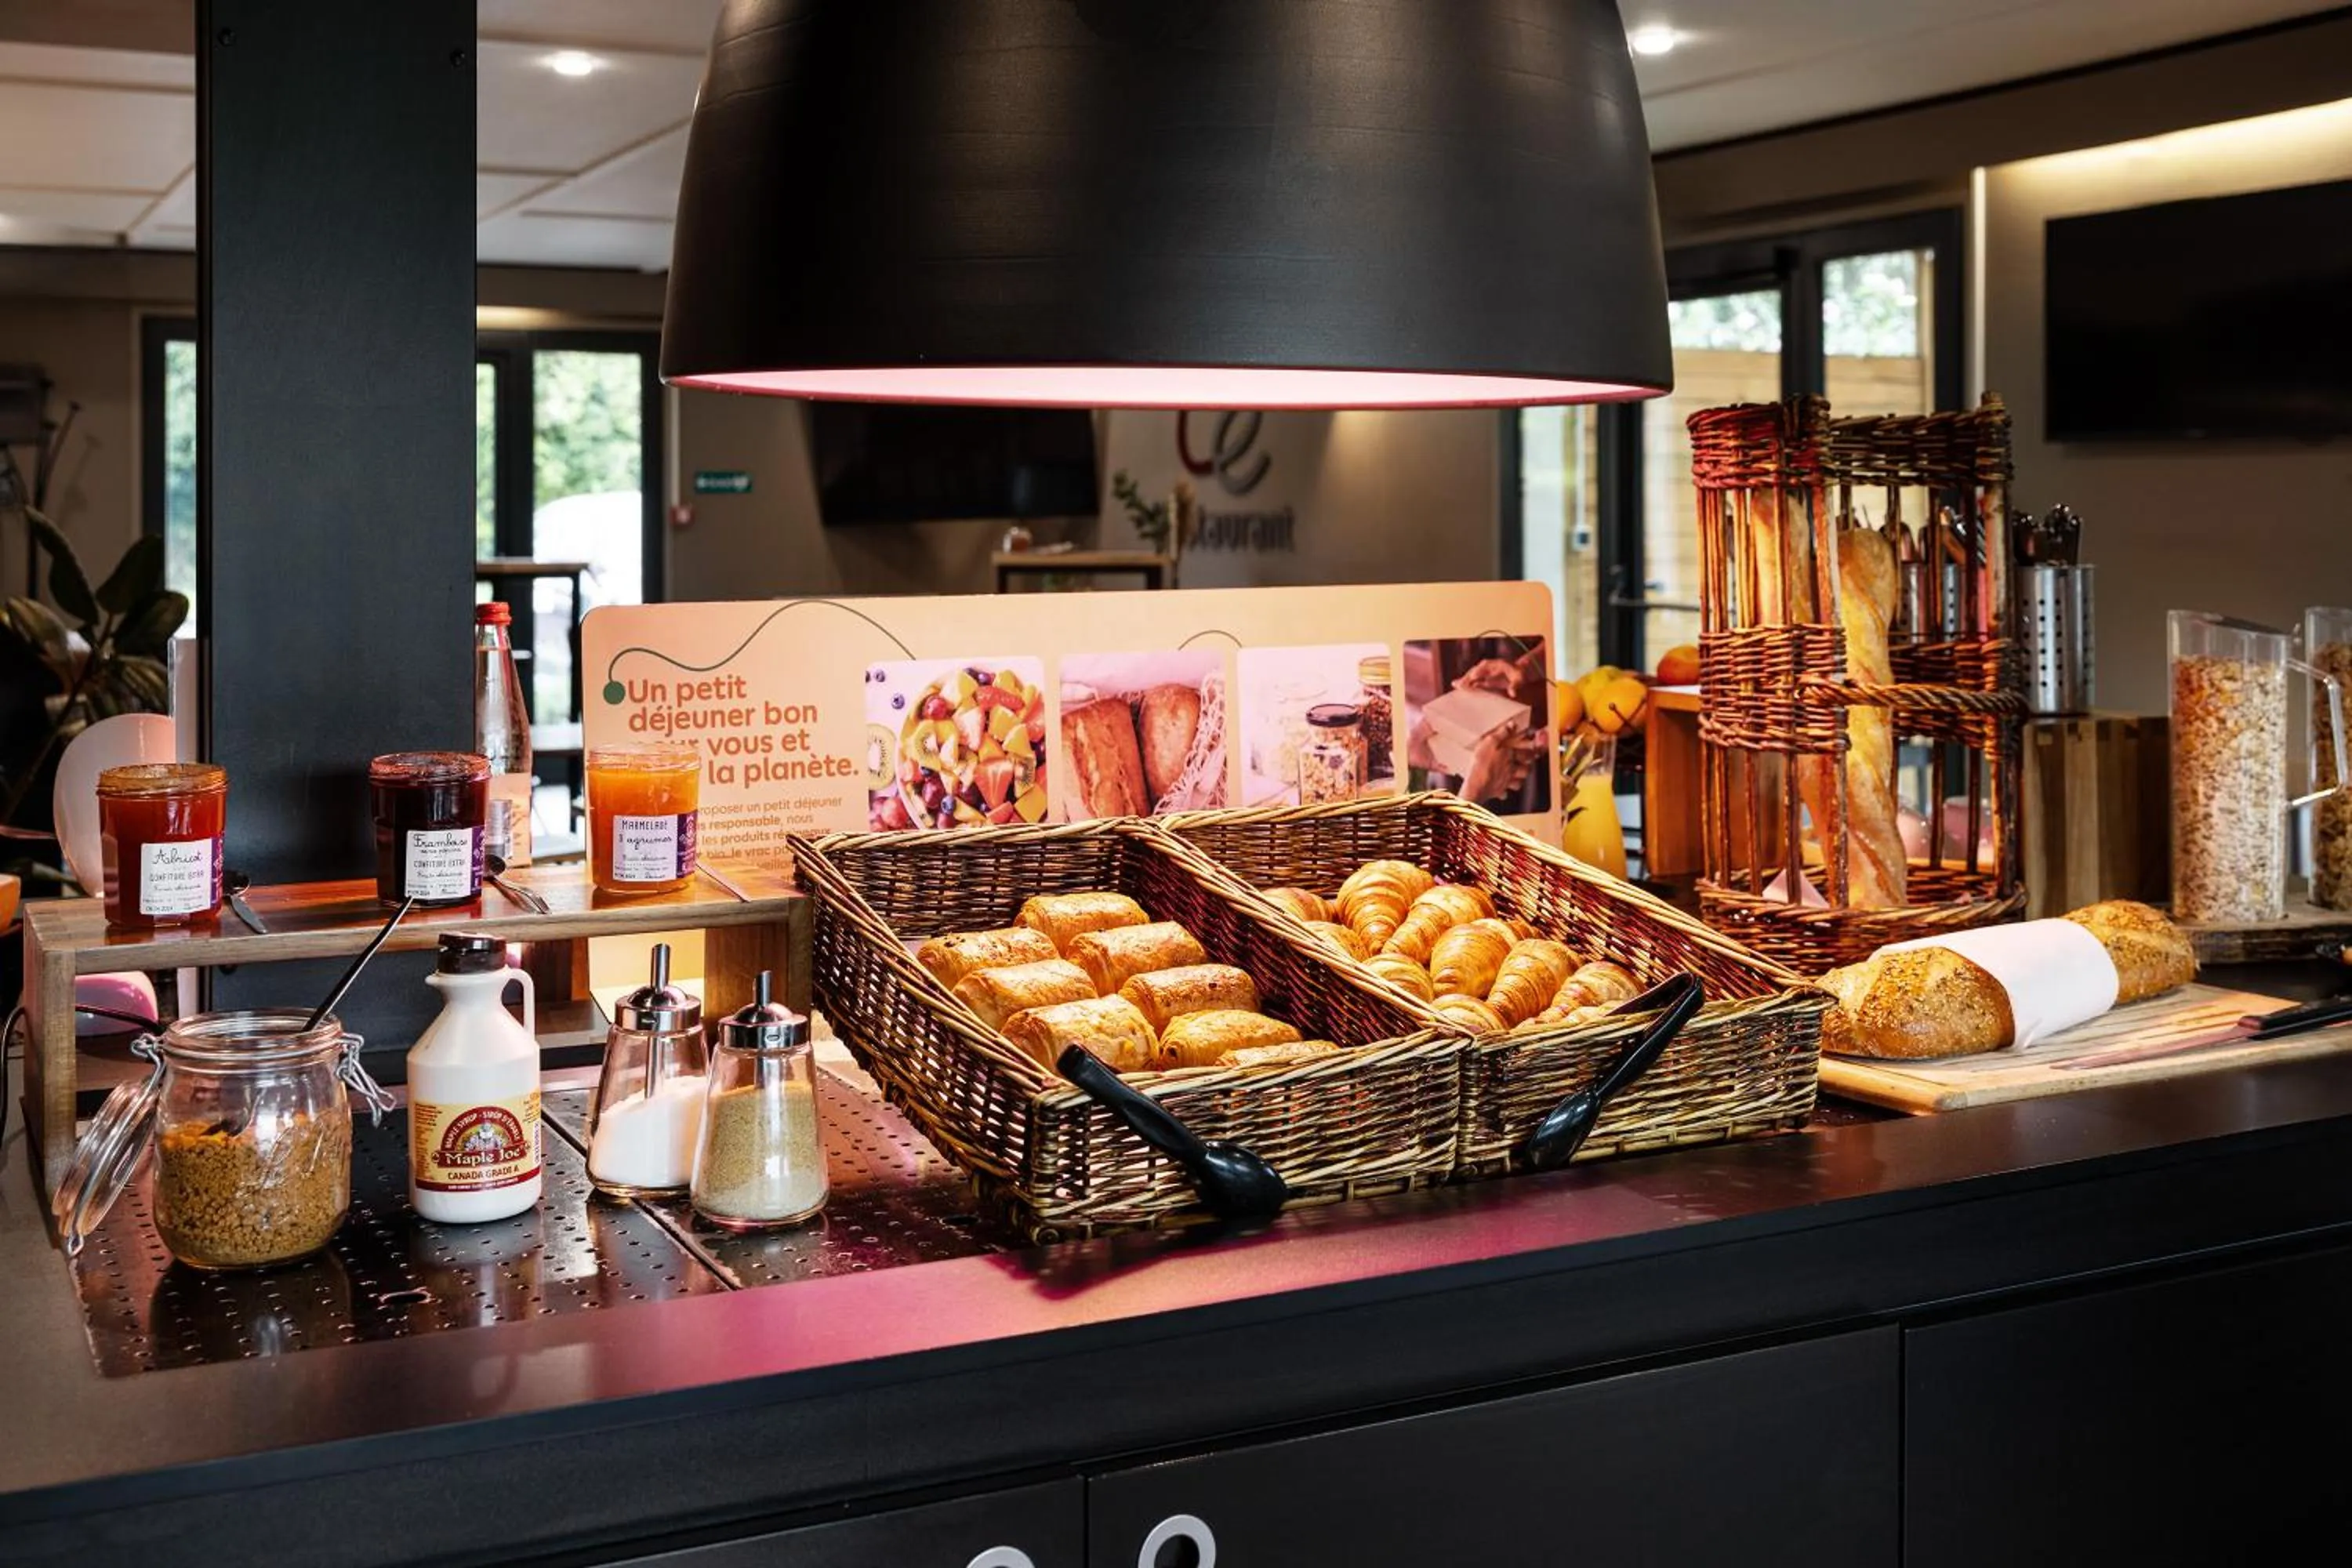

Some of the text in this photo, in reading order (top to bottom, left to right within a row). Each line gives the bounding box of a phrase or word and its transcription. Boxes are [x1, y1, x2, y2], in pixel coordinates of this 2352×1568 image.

[628, 674, 747, 707] Un petit
[629, 701, 818, 738] déjeuner bon
[707, 734, 773, 757] vous
[782, 729, 811, 752] et
[709, 755, 859, 789] la planète.
[699, 796, 843, 818] roposer un petit déjeuner
[622, 820, 668, 830] MARMELADE
[709, 815, 783, 831] responsable,
[786, 815, 814, 823] nous
[702, 836, 717, 845] les
[720, 831, 771, 845] produits
[152, 848, 202, 865] Abricot
[731, 848, 742, 858] le
[747, 847, 771, 856] vrac
[445, 1148, 521, 1167] Maple Joe
[448, 1170, 484, 1180] CANADA
[485, 1167, 510, 1178] GRADE
